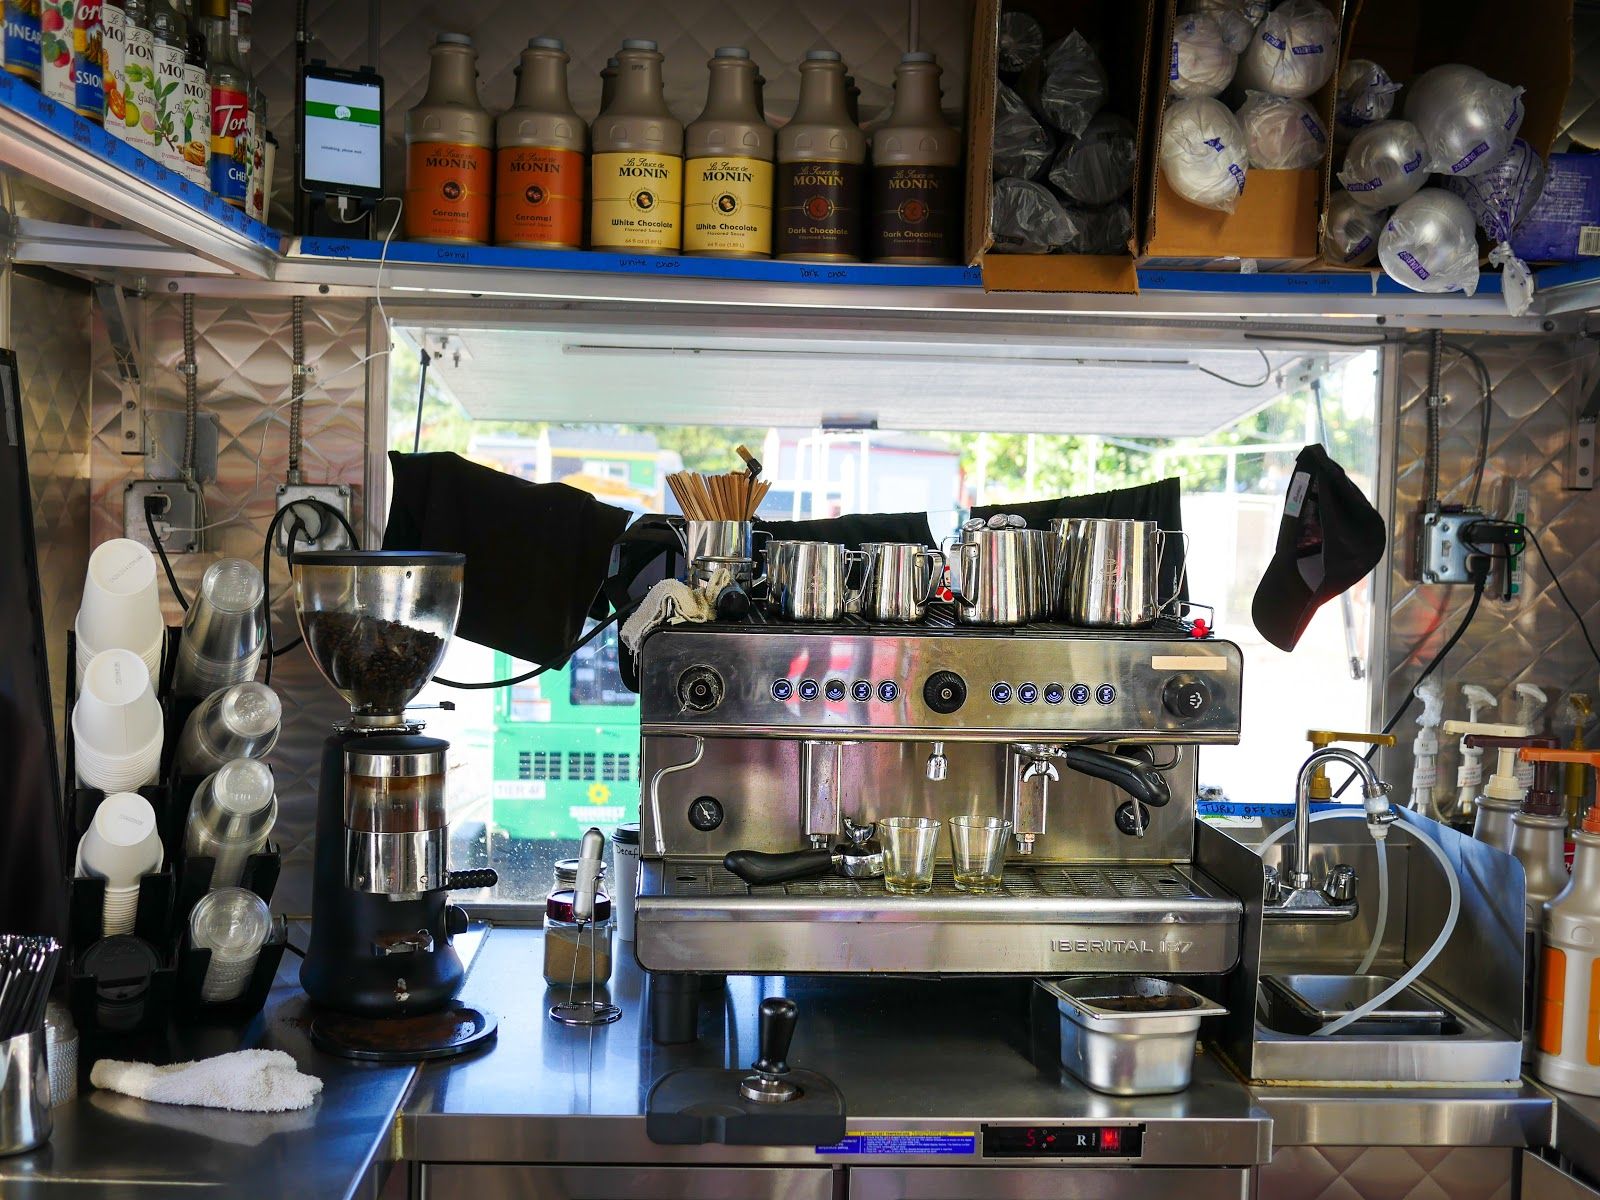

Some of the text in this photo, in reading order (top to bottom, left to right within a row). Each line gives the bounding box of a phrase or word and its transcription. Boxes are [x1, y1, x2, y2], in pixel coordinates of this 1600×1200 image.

[425, 157, 477, 170] MONIN
[510, 162, 560, 173] MONIN
[636, 158, 657, 167] Sauce
[718, 161, 740, 170] Sauce
[619, 167, 669, 179] MONIN
[702, 171, 753, 182] MONIN
[793, 175, 844, 186] MONIN
[889, 179, 939, 190] MONIN
[432, 208, 469, 219] Caramel
[515, 213, 552, 222] Caramel
[611, 218, 673, 229] White Chocolate
[696, 223, 757, 232] White Chocolate
[787, 227, 849, 236] Dark Chocolate
[883, 230, 943, 239] Dark Chocolate
[1201, 804, 1236, 815] TURN
[616, 844, 639, 859] Decaf
[1050, 939, 1153, 953] IBERITAL
[1077, 1135, 1087, 1147] R
